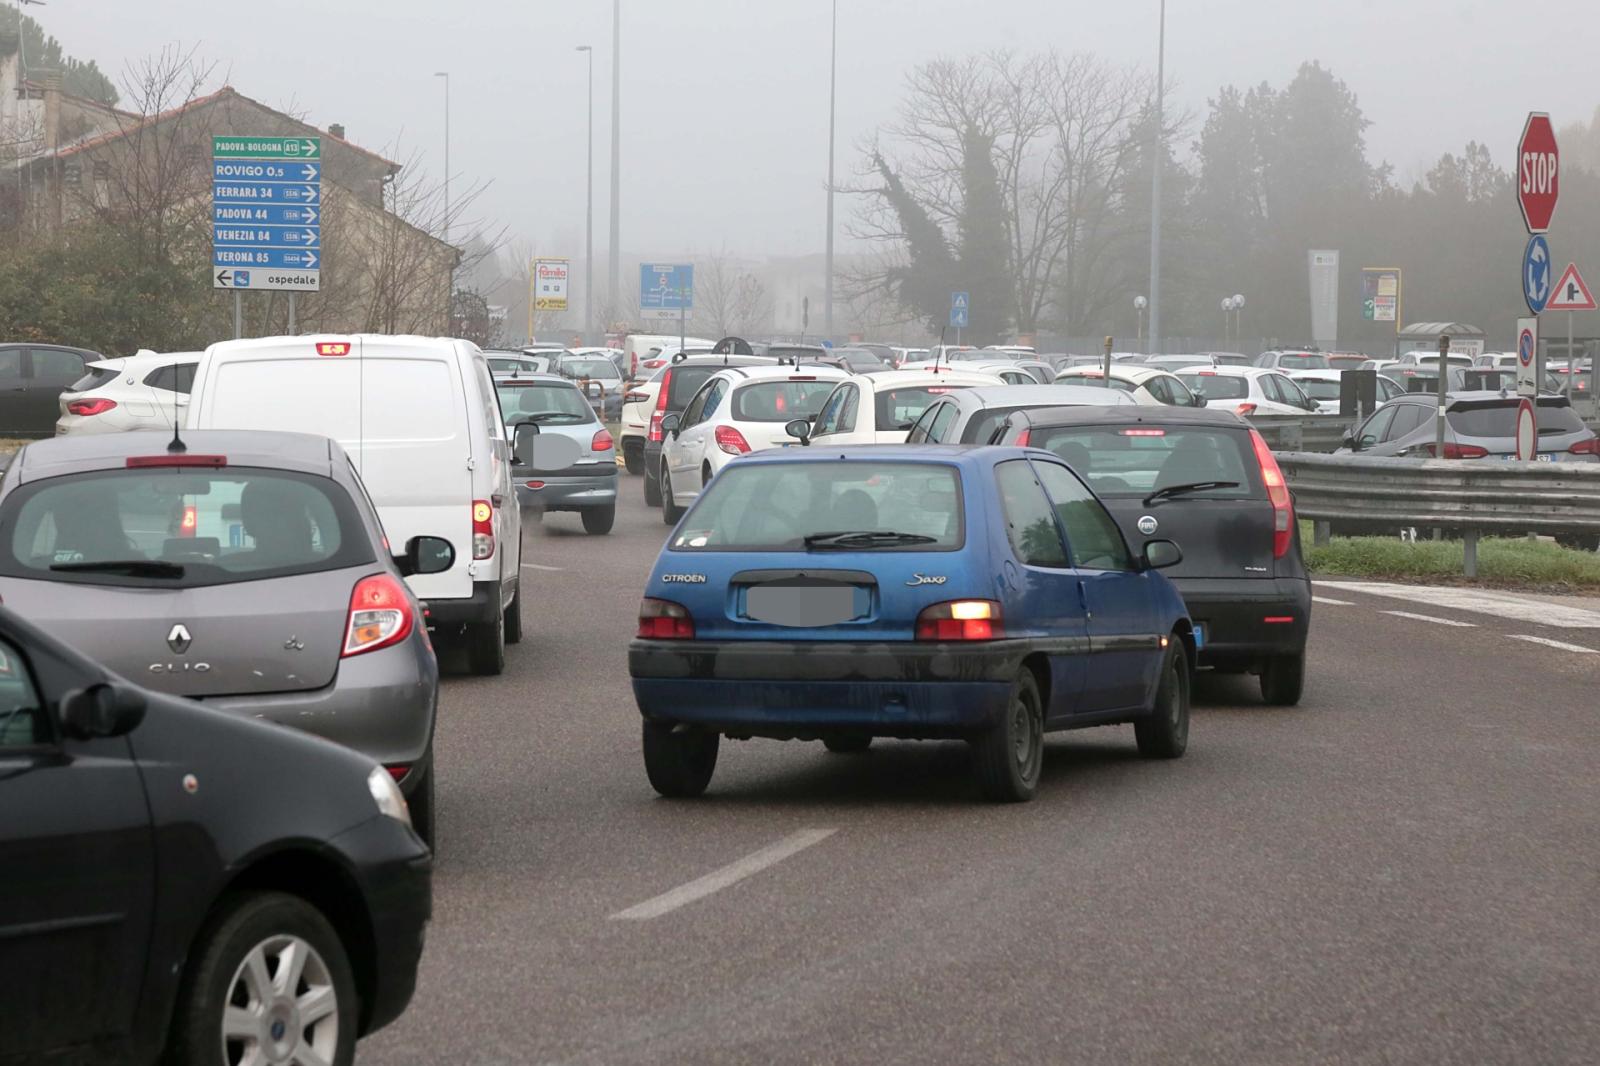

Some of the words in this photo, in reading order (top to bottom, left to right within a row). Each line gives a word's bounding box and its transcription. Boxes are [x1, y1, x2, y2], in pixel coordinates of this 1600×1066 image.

[286, 144, 298, 152] A13
[216, 165, 263, 176] ROVIGO
[1523, 152, 1556, 194] STOP
[216, 187, 257, 197] FERRARA
[261, 188, 272, 198] 34
[216, 208, 252, 219] PADOVA
[256, 209, 268, 219] 44
[217, 230, 254, 241] VENEZIA
[217, 251, 254, 262] VERONA
[256, 252, 269, 263] 85
[538, 265, 566, 279] famila
[268, 276, 316, 285] ospedale
[905, 573, 947, 586] Saxo
[149, 662, 211, 673] CLIO
